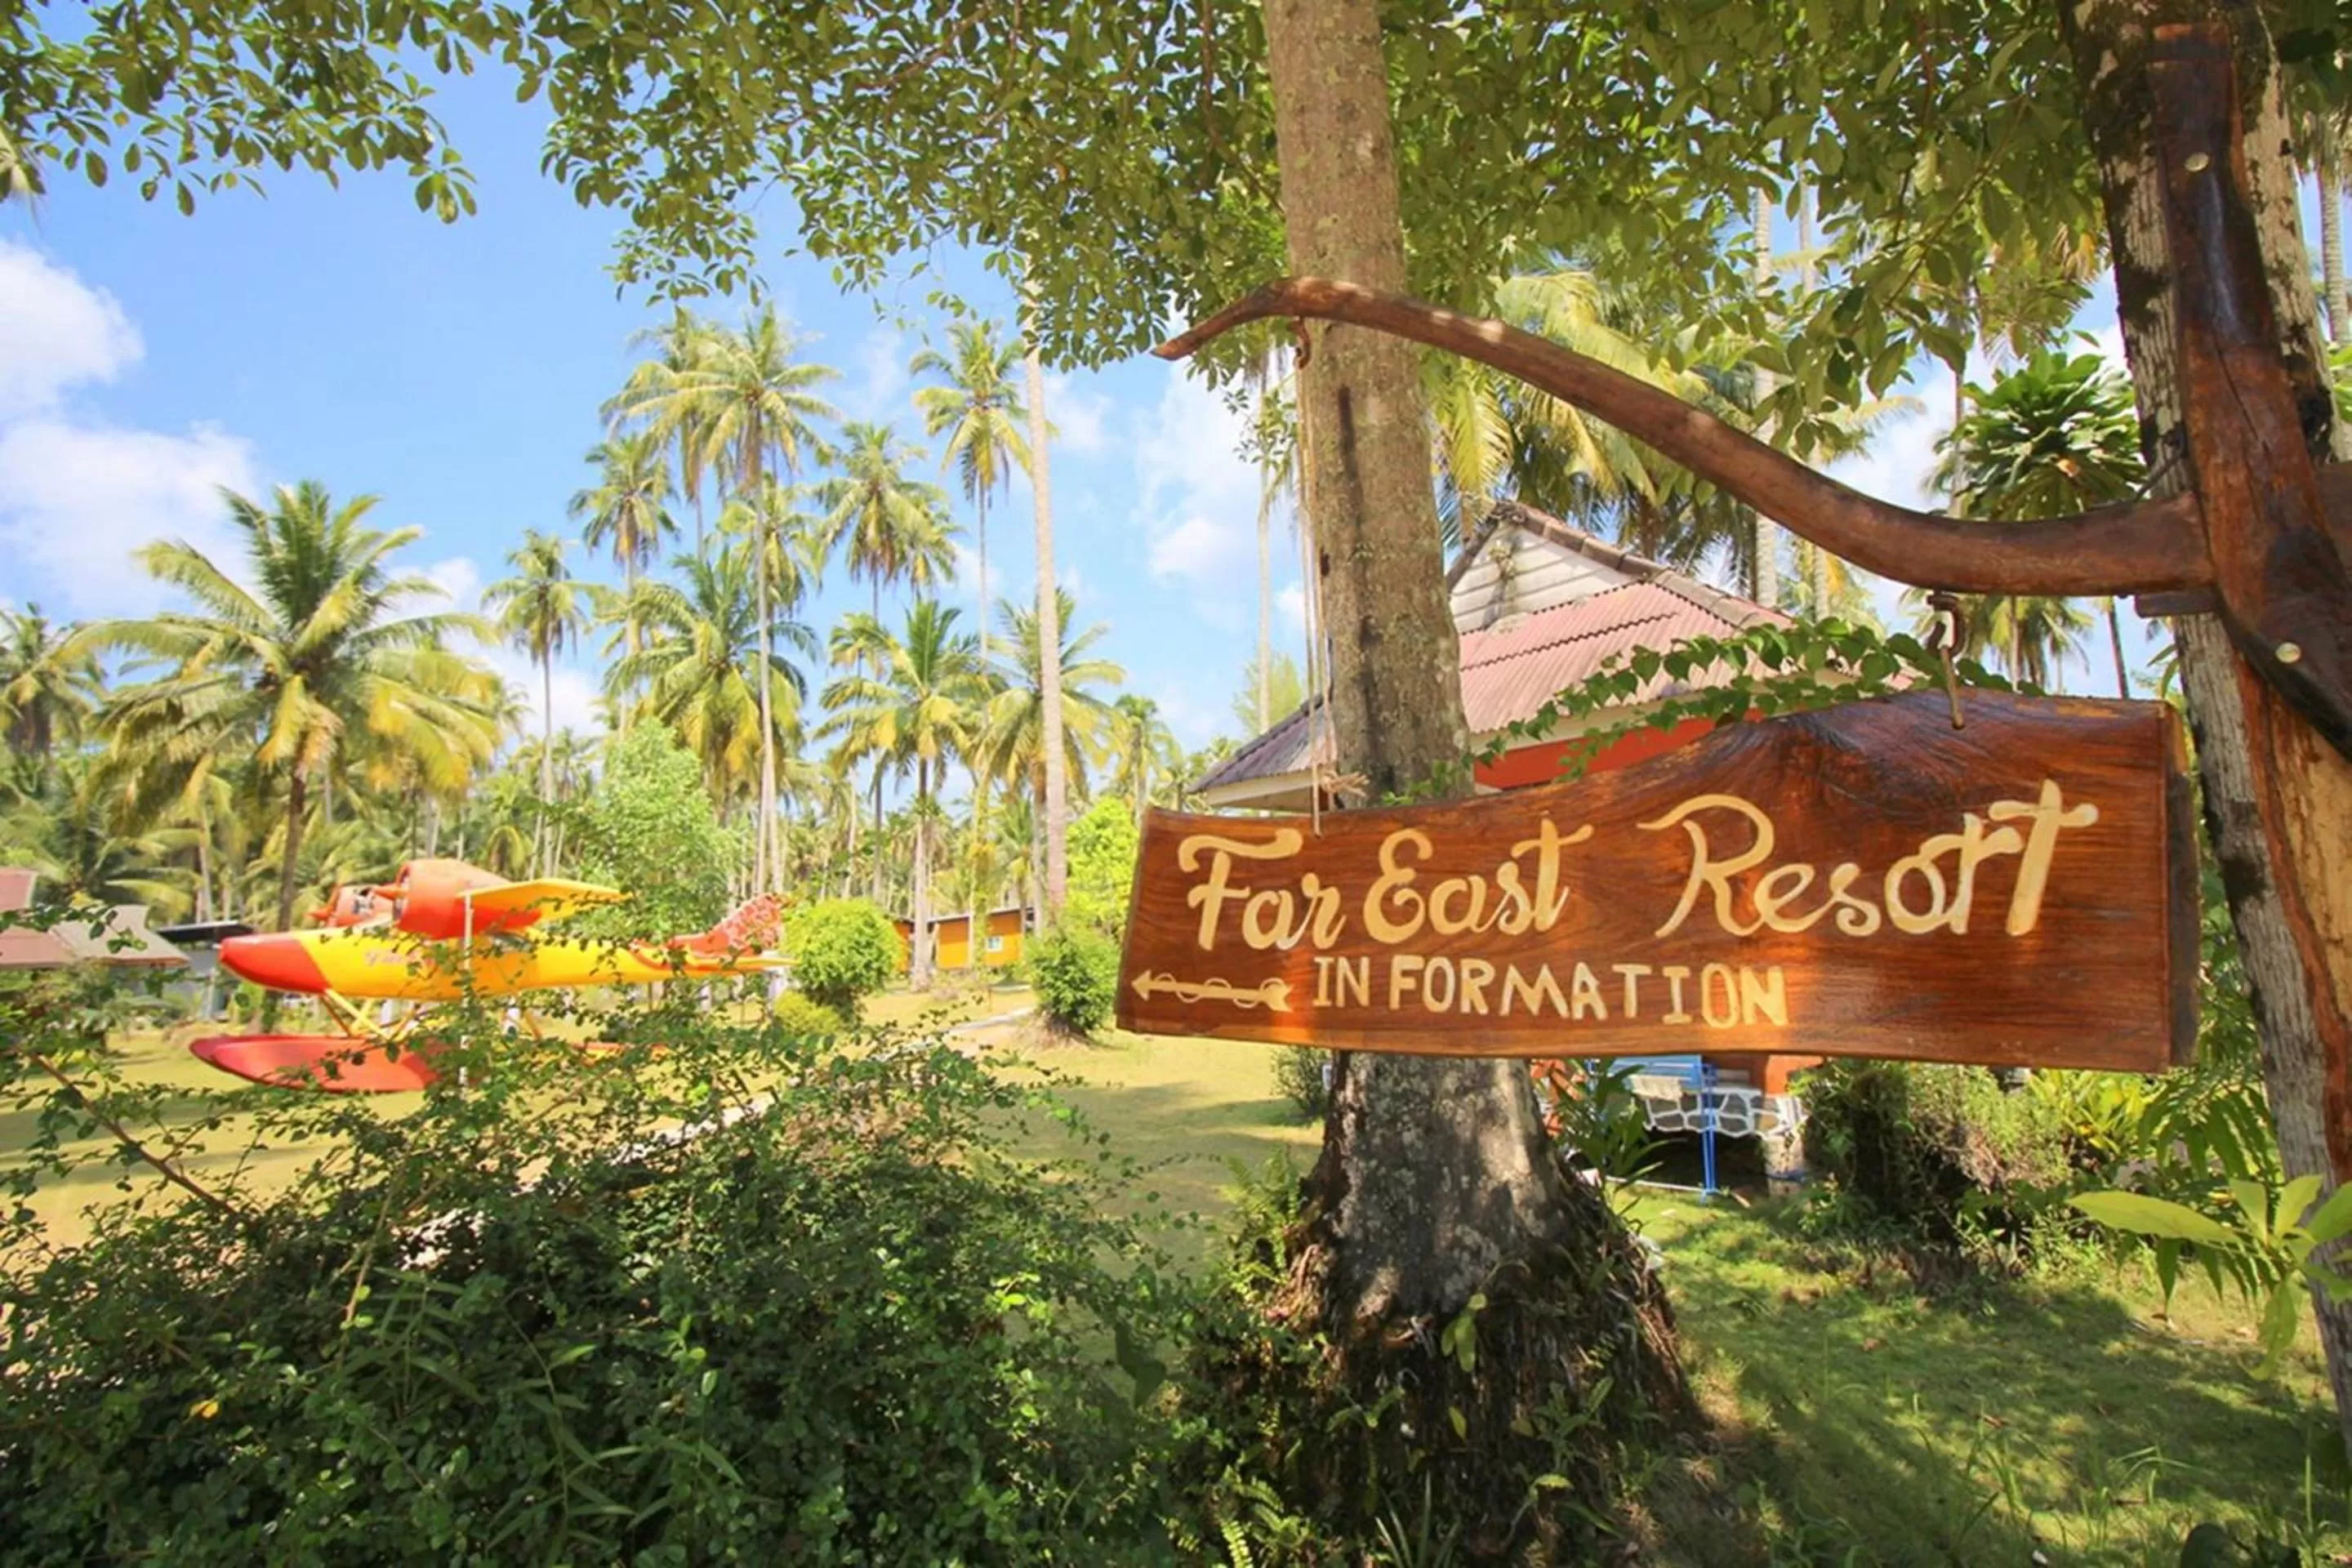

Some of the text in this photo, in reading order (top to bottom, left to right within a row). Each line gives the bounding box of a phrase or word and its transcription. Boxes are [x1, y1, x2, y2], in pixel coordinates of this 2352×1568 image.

[1178, 779, 2100, 951] Far East Resort
